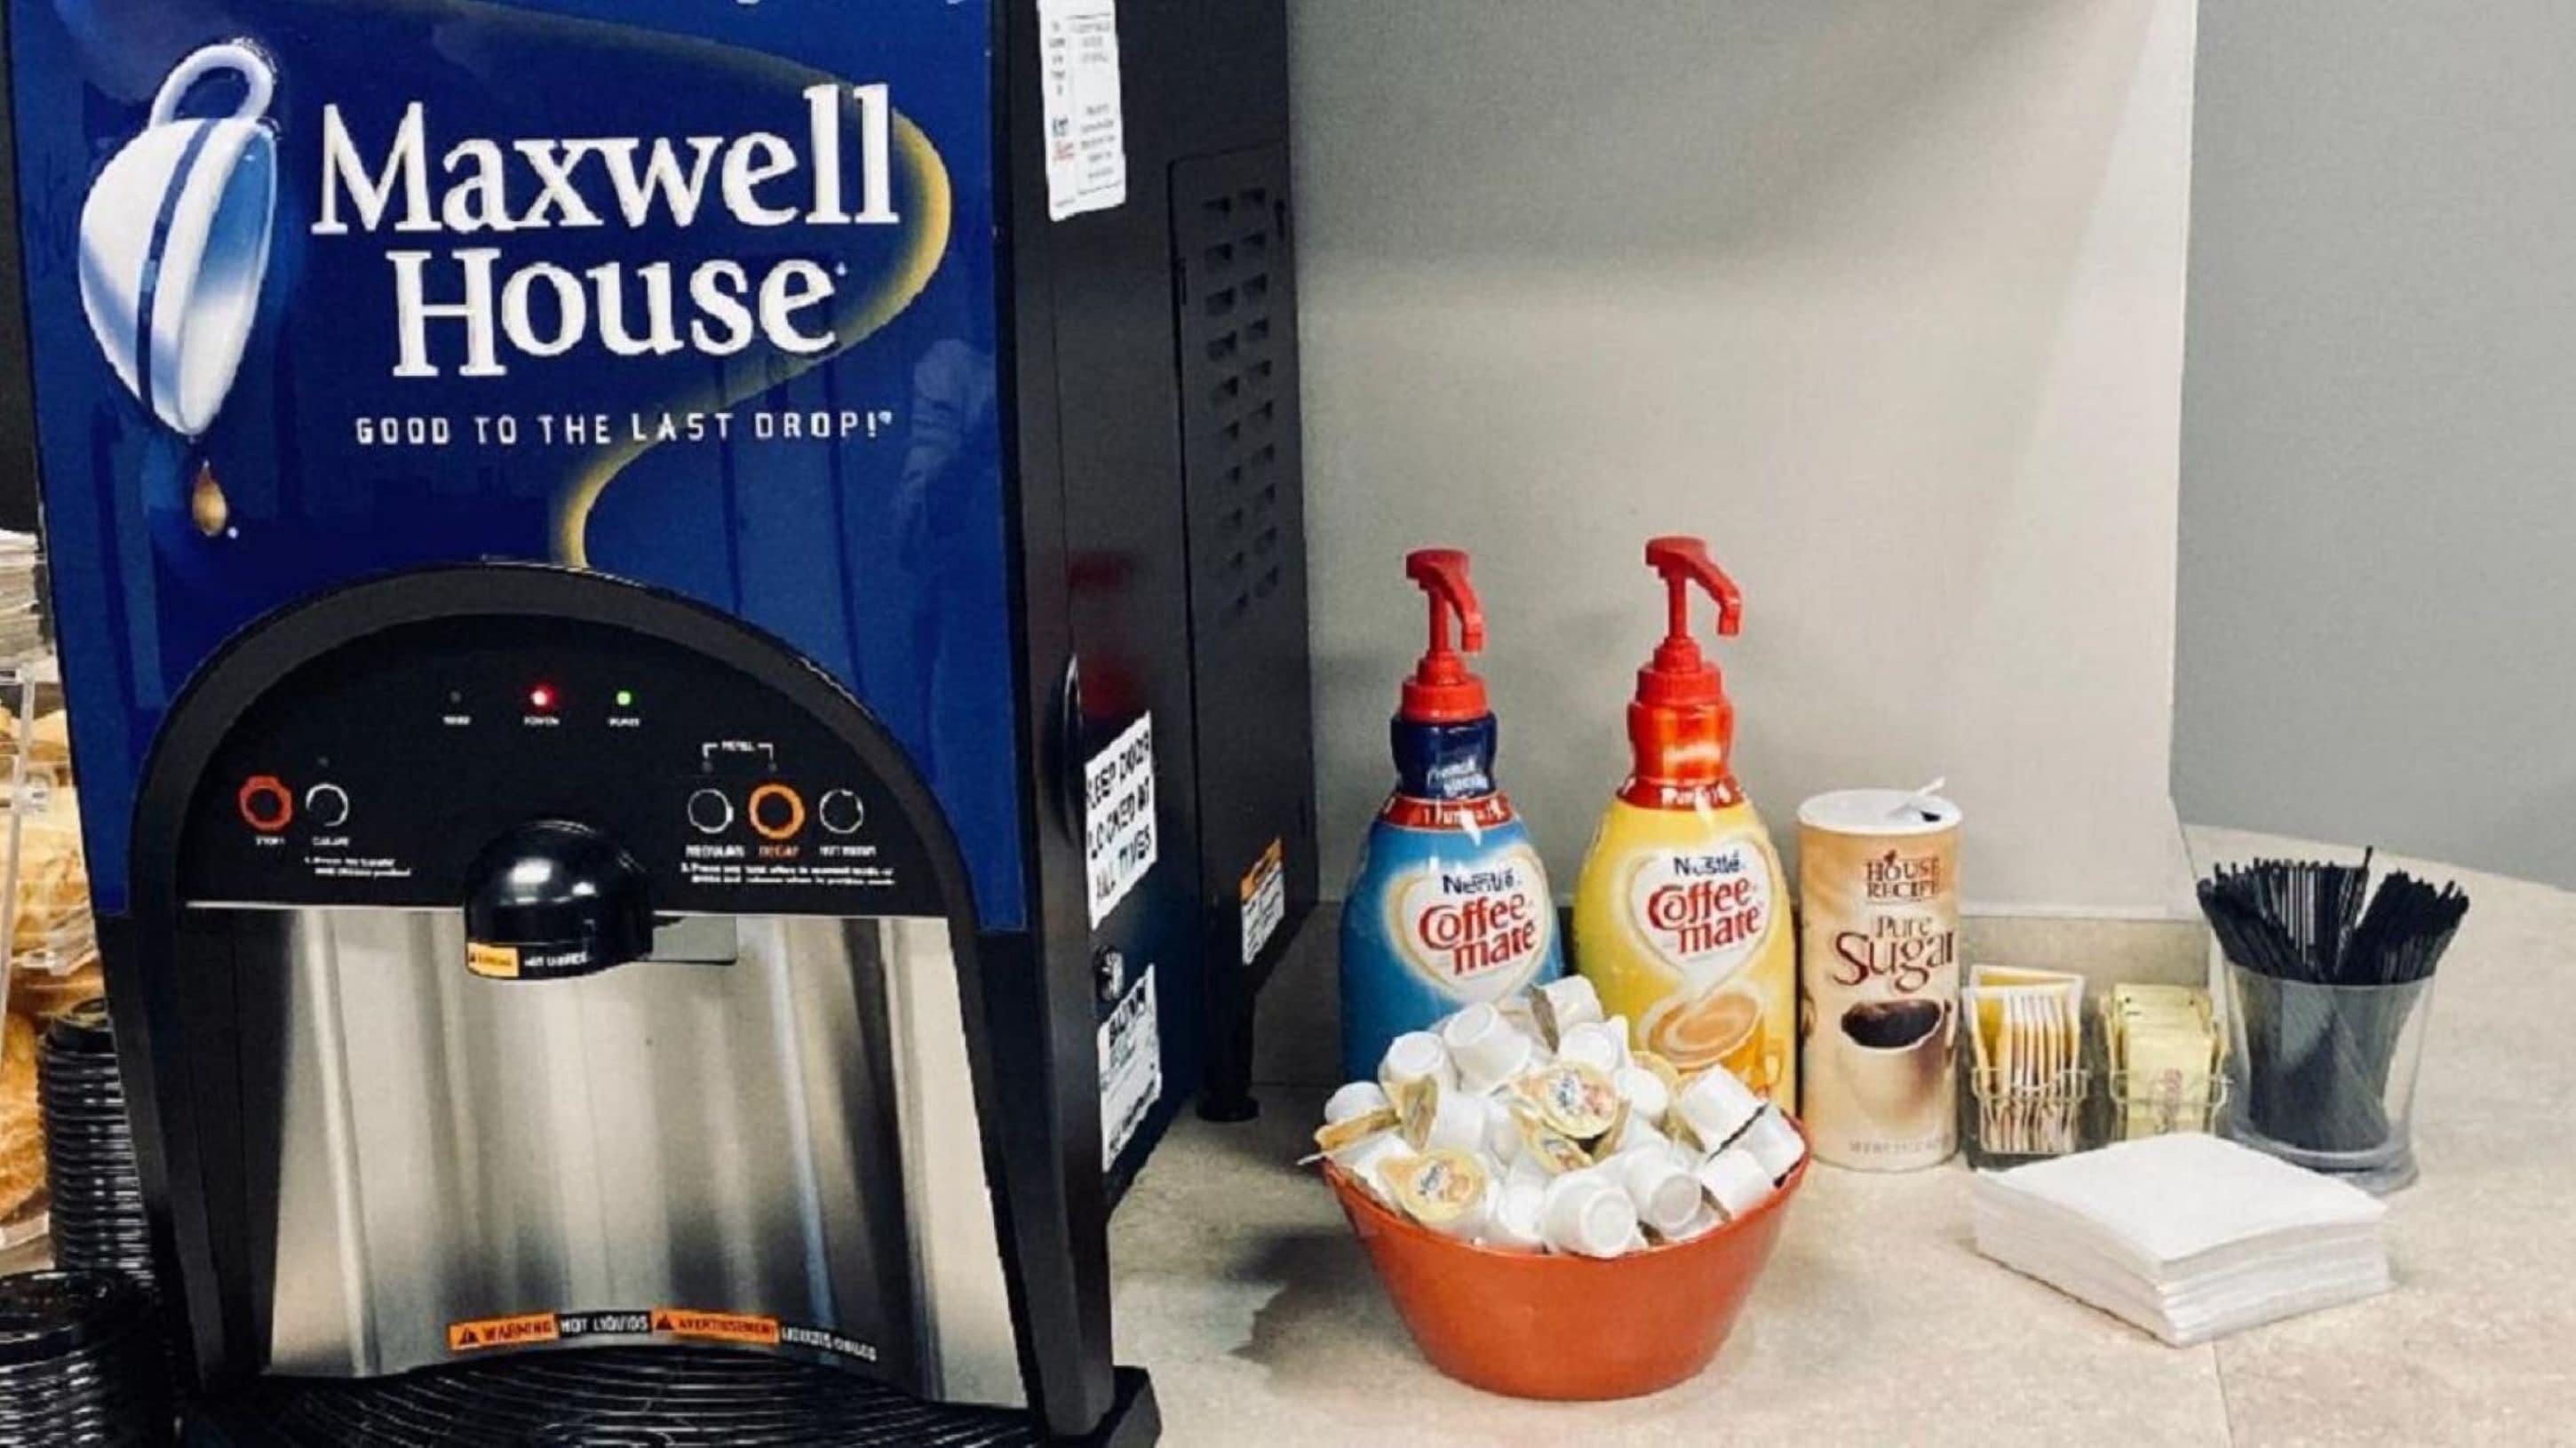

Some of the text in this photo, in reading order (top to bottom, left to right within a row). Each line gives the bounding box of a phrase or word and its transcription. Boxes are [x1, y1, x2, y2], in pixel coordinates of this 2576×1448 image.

[311, 84, 900, 235] Maxwell
[386, 247, 838, 378] House
[355, 415, 451, 445] GOOD
[475, 415, 518, 445] TO
[542, 413, 611, 443] THE
[632, 411, 735, 442] LAST
[1866, 856, 1940, 883] HOUSE
[1420, 894, 1526, 951] Coffee
[1648, 877, 1752, 930] Coffee
[1875, 915, 1933, 940] Pure
[1453, 922, 1537, 975] mate
[1678, 908, 1761, 955] mate
[1833, 930, 1954, 994] Sugar
